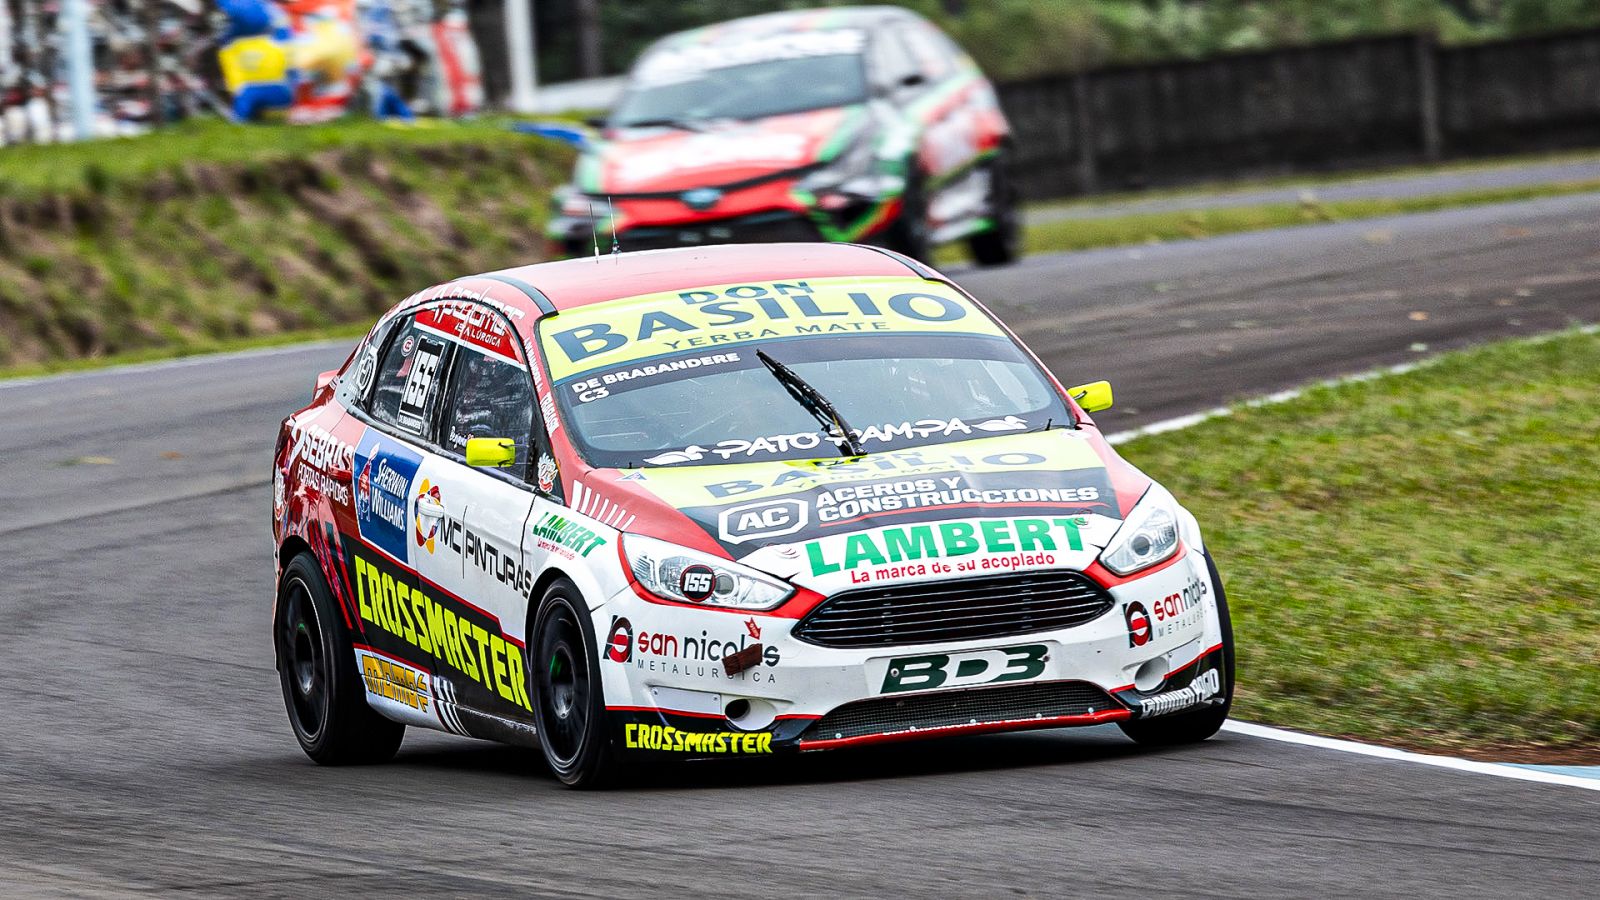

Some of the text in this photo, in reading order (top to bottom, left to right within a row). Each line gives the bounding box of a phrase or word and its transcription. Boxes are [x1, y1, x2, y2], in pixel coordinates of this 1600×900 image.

[679, 282, 814, 305] DON
[551, 292, 967, 363] BASILIO
[664, 322, 890, 350] YERBA MATE
[402, 350, 439, 409] 155
[571, 353, 740, 393] DE BRABANDERE
[577, 387, 609, 405] C3
[302, 424, 355, 472] SEBRAS
[712, 433, 820, 459] PATO
[825, 418, 972, 446] PAMPA
[374, 458, 408, 499] SHERWIN
[816, 479, 936, 508] ACEROS
[940, 477, 962, 489] Y
[371, 491, 405, 530] WILLIAMS
[737, 507, 790, 531] AC
[817, 487, 1100, 522] CONSTRUCCIONES
[532, 512, 607, 558] LAMBERT
[805, 518, 1085, 577] LAMBERT
[439, 515, 461, 554] MC
[465, 529, 532, 599] PINTURAS
[851, 570, 870, 583] La
[876, 564, 925, 580] marca
[932, 561, 951, 573] de
[981, 553, 1055, 571] acoplado
[683, 573, 712, 592] 155
[1154, 593, 1184, 621] san
[355, 555, 533, 712] CROSSMASTER
[638, 630, 780, 666] san nicols
[880, 644, 1048, 694] BD3
[625, 723, 773, 753] CROSSMASTER
